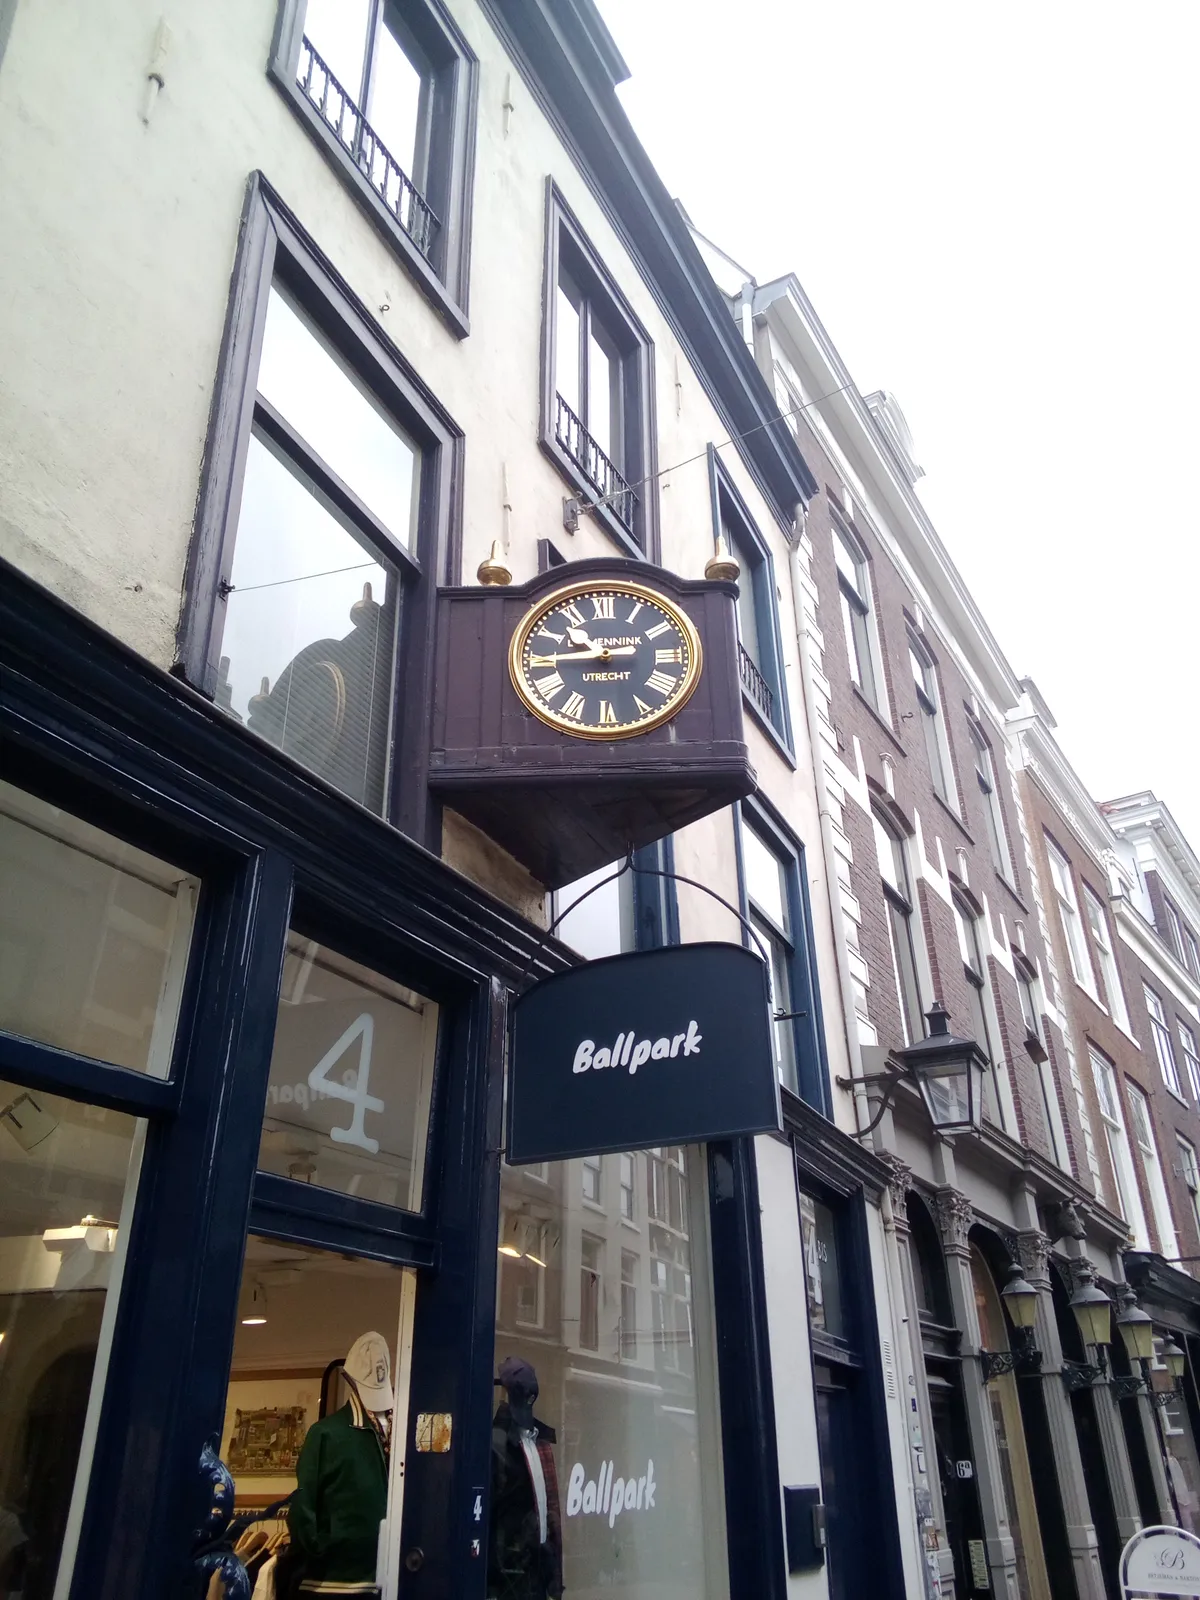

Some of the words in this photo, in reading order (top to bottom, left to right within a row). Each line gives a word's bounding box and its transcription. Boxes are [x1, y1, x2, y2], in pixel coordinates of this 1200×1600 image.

[558, 603, 588, 628] XI
[590, 597, 616, 620] XII
[625, 602, 644, 625] I
[537, 626, 566, 644] X
[644, 620, 673, 641] II
[655, 646, 682, 665] III
[533, 670, 566, 702] VIII
[582, 671, 631, 682] UTRECHT
[558, 690, 586, 720] VII
[633, 694, 653, 715] V
[572, 1020, 703, 1075] Ballpark
[308, 1013, 385, 1155] 4
[808, 1224, 822, 1304] 4
[566, 1458, 657, 1529] Ballpark
[473, 1495, 482, 1521] 4
